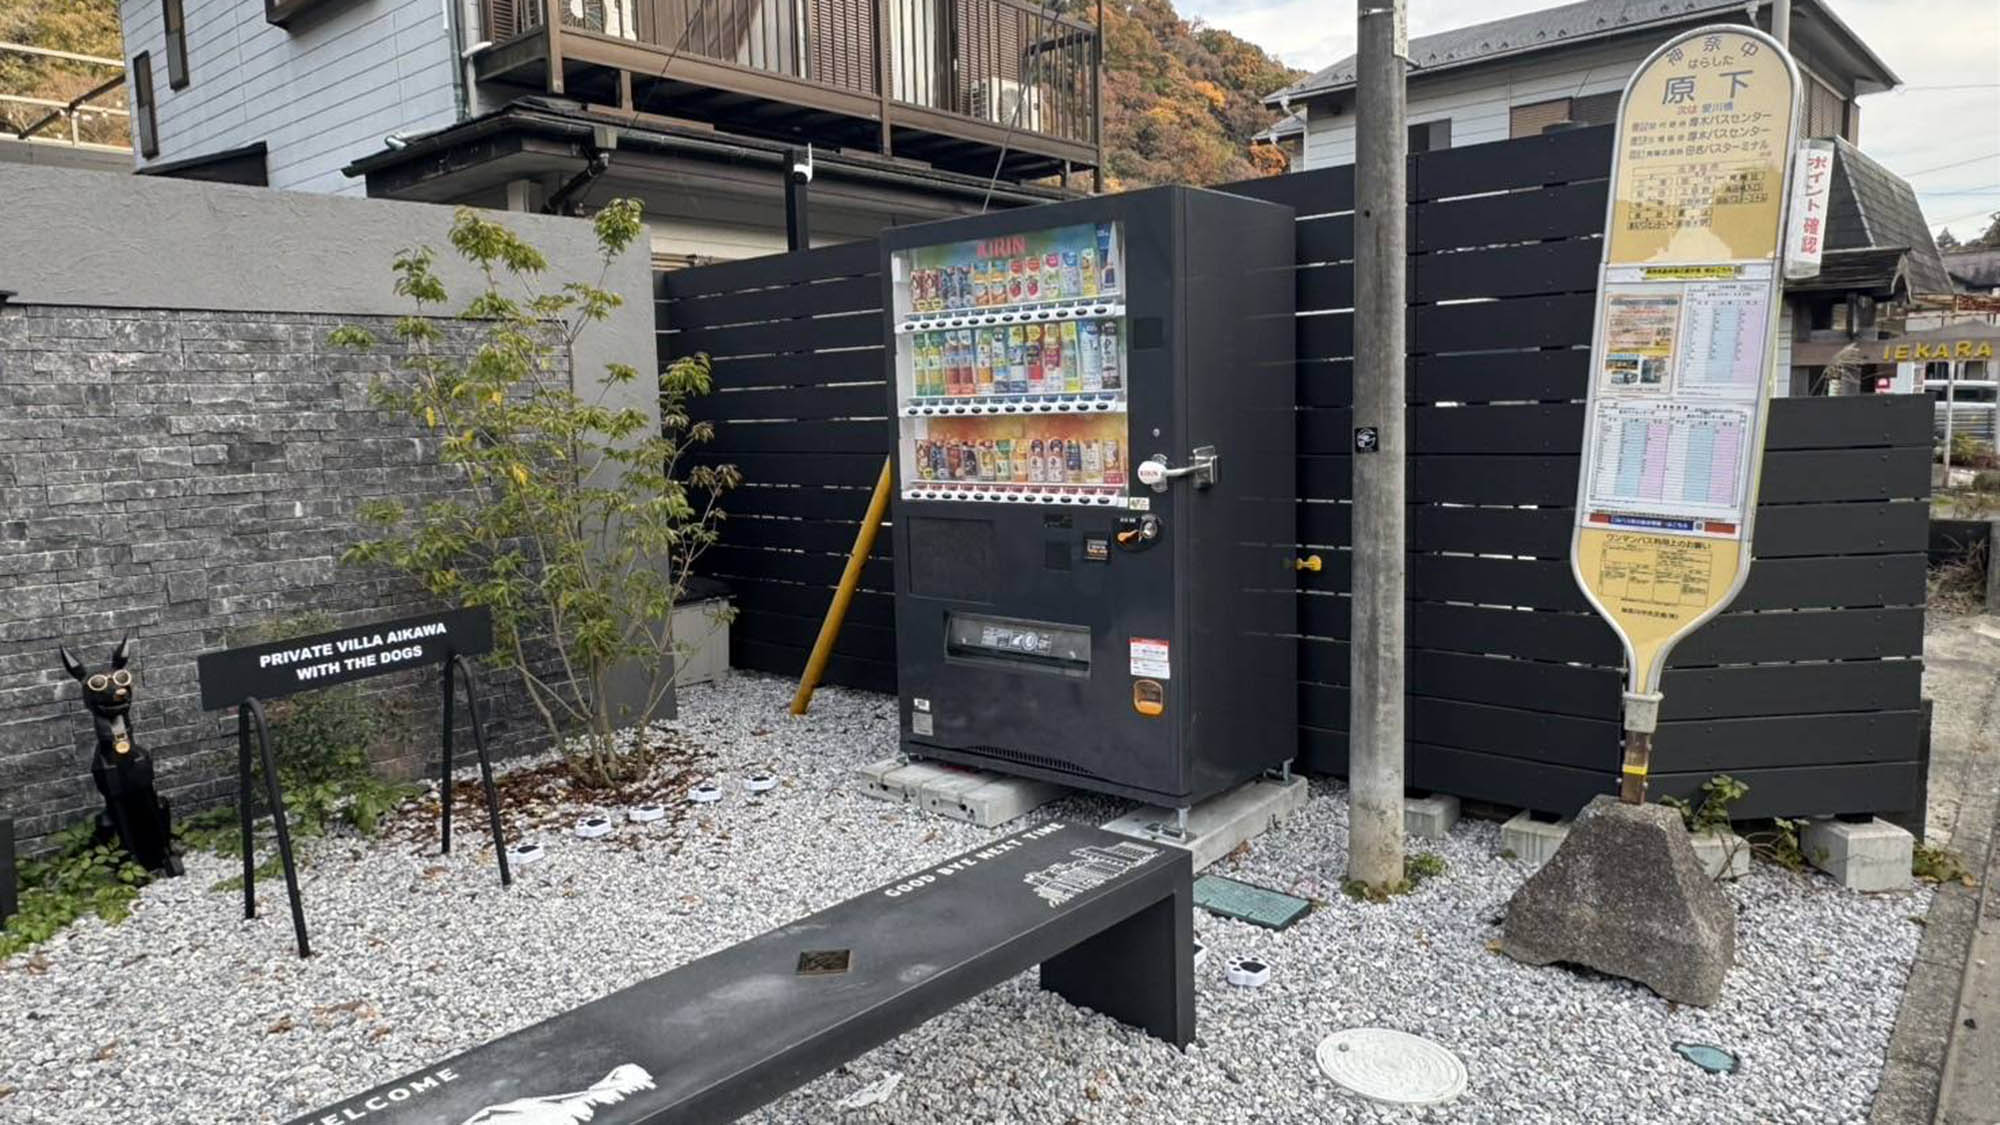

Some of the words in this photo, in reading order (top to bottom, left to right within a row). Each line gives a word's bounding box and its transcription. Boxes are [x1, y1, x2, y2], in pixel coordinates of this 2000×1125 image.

[1688, 54, 1734, 70] はらした
[1800, 155, 1828, 254] ポイント確認
[976, 237, 1027, 258] KIRIN
[259, 643, 333, 668] PRIVATE
[336, 634, 384, 653] VILLA
[386, 622, 447, 643] AIKAWA
[296, 662, 341, 681] WITH
[344, 654, 377, 671] THE
[380, 645, 423, 664] DOGS
[884, 874, 936, 898] GOOD
[937, 858, 977, 876] BYE
[1021, 822, 1066, 841] TIME
[306, 1067, 460, 1125] ELCOME
